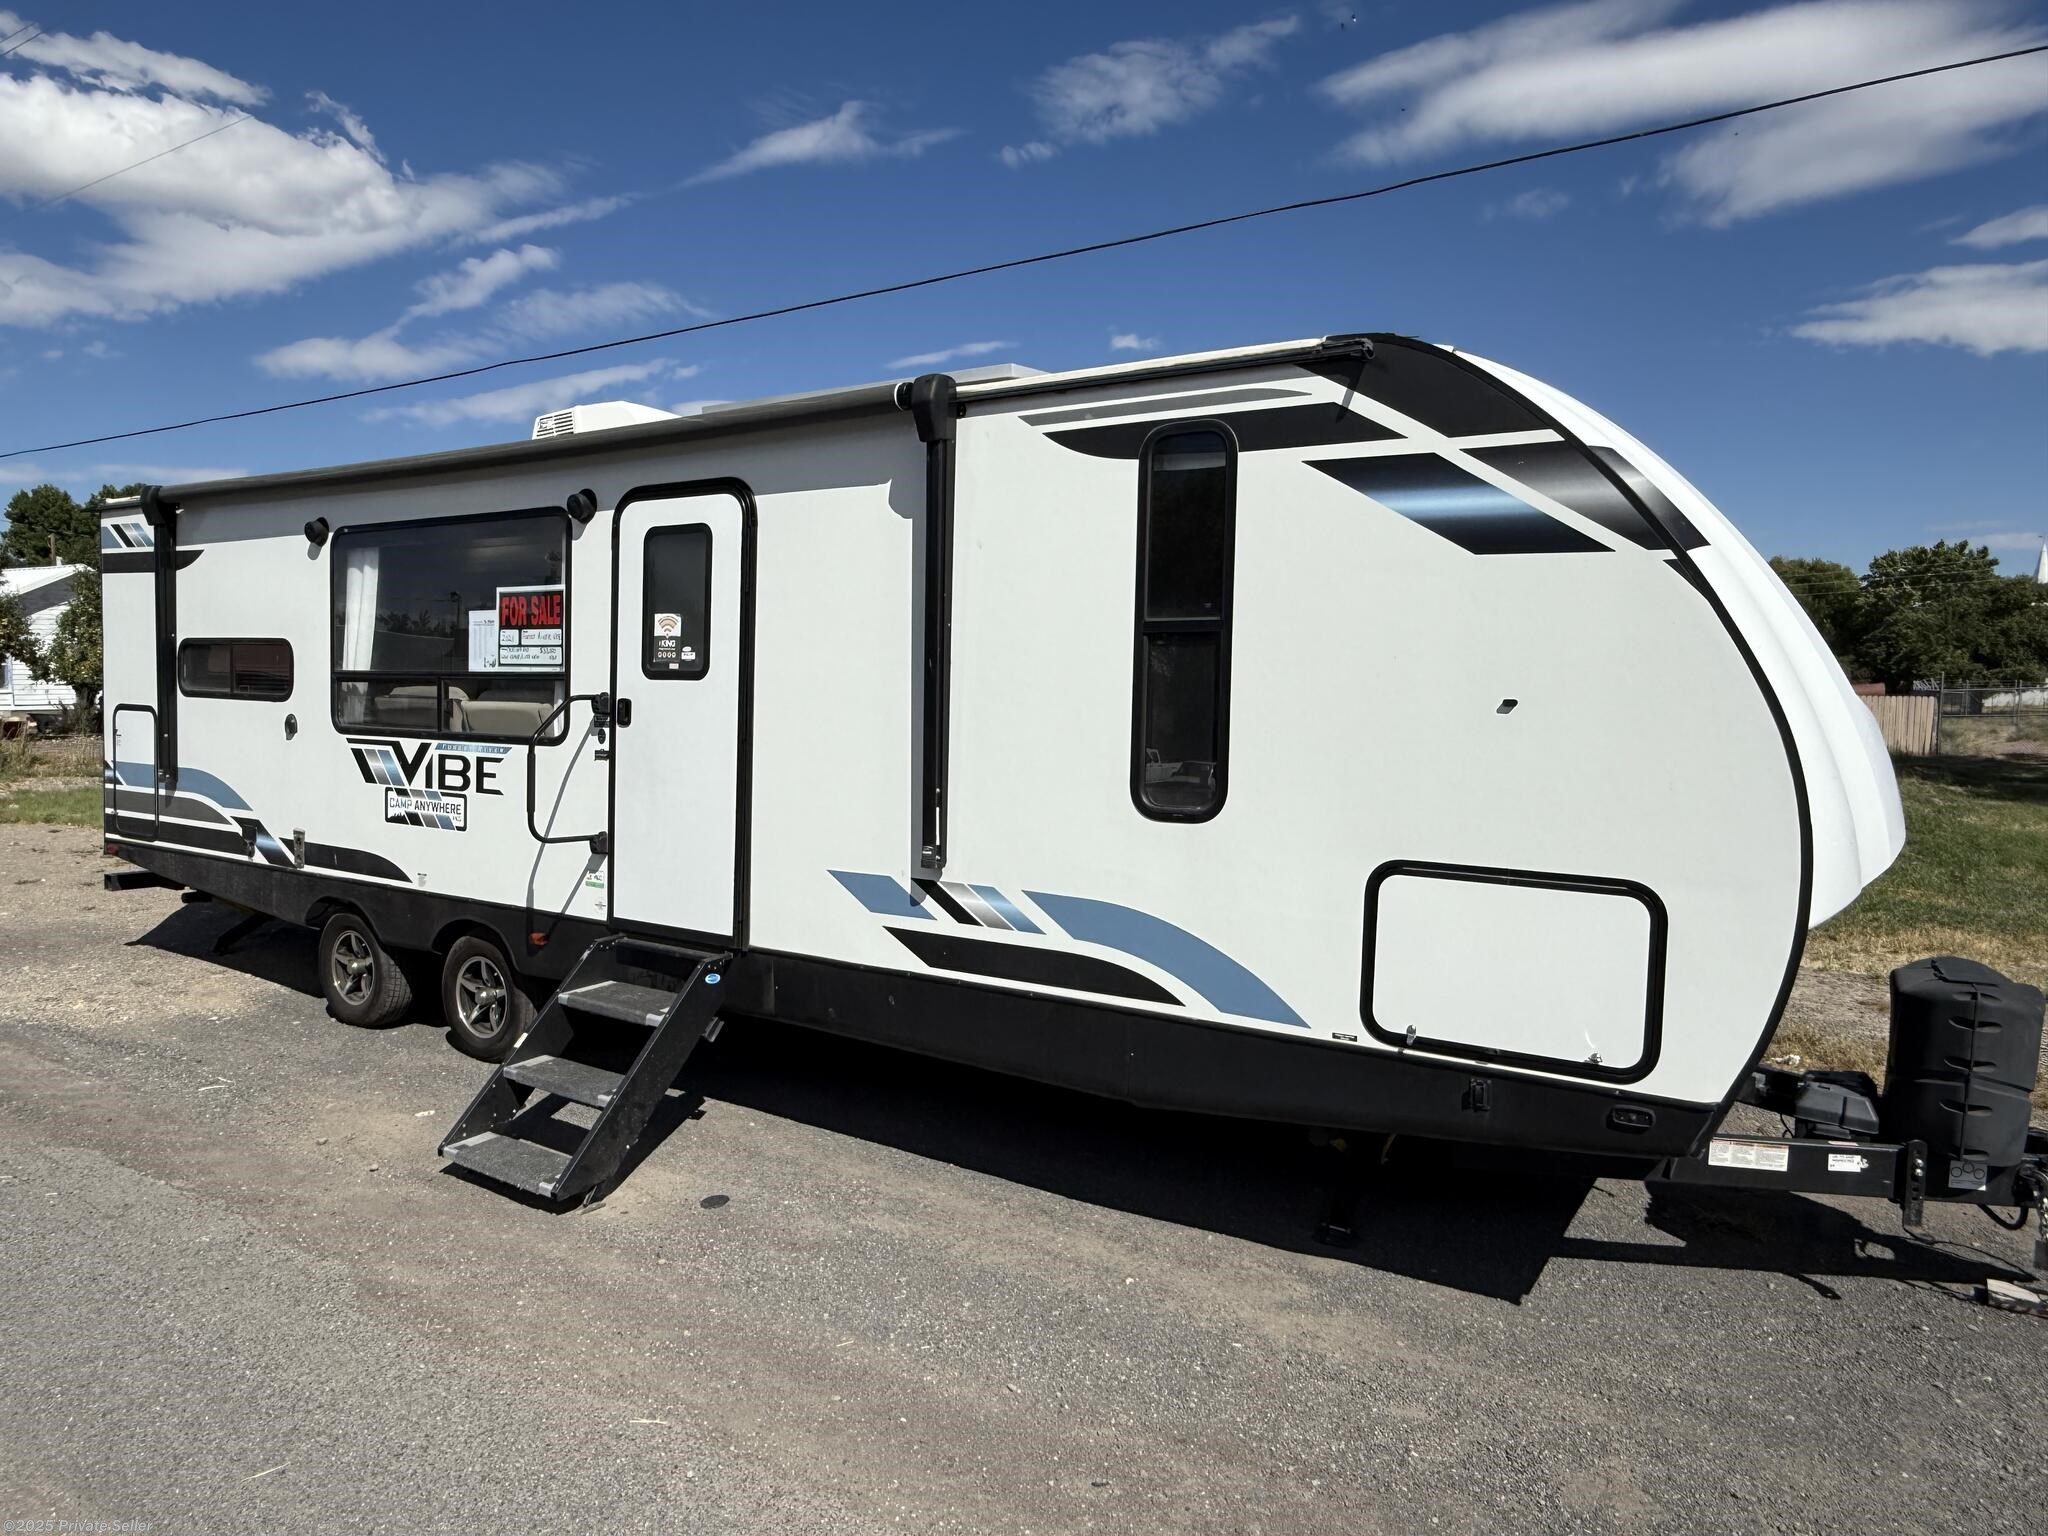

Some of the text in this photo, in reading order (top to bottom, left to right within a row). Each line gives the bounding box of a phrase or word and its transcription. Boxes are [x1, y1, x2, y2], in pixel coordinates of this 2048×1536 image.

[501, 594, 561, 626] FOR SALE
[346, 738, 505, 796] VIBE
[390, 797, 462, 815] CAMP ANYWHERE
